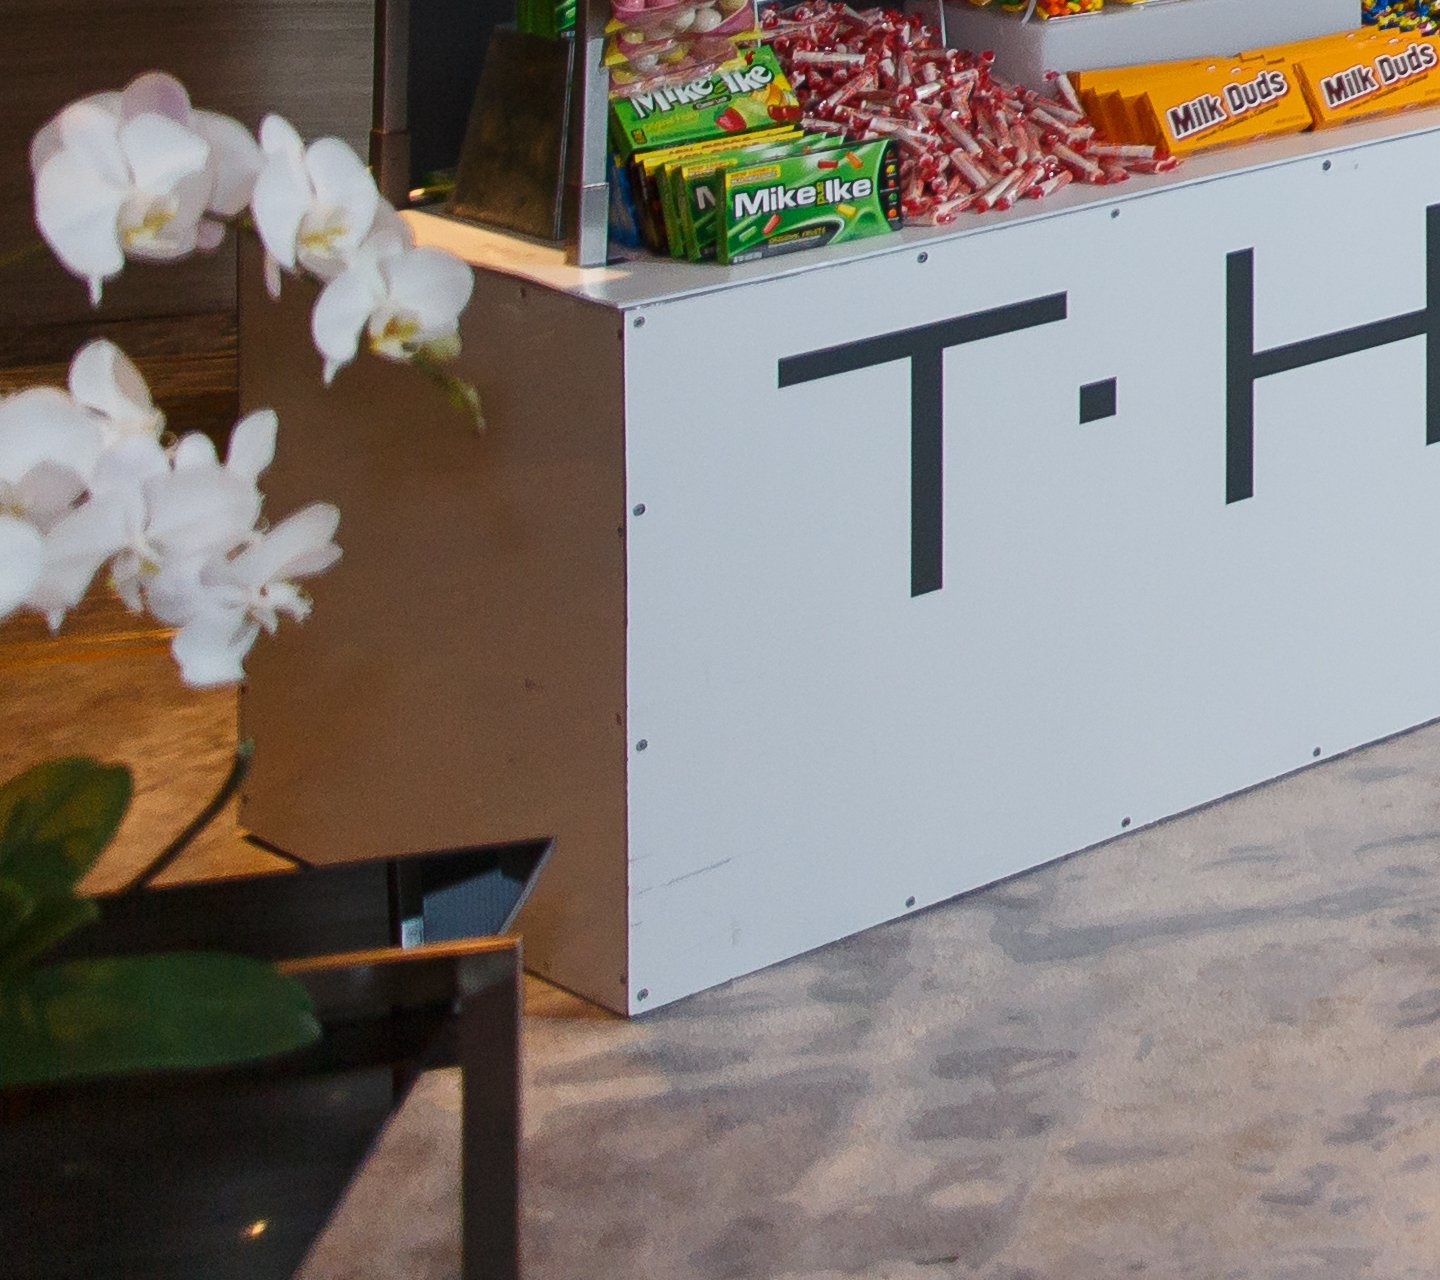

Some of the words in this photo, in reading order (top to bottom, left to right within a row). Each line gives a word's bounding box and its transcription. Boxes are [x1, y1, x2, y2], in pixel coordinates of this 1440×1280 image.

[629, 77, 714, 120] Mike
[721, 64, 774, 94] Ike
[1167, 93, 1228, 140] Milk
[1224, 71, 1288, 114] Duds
[1321, 65, 1379, 108] Milk
[1376, 42, 1438, 85] Duds
[733, 186, 816, 219] Mike
[825, 177, 873, 204] Ike
